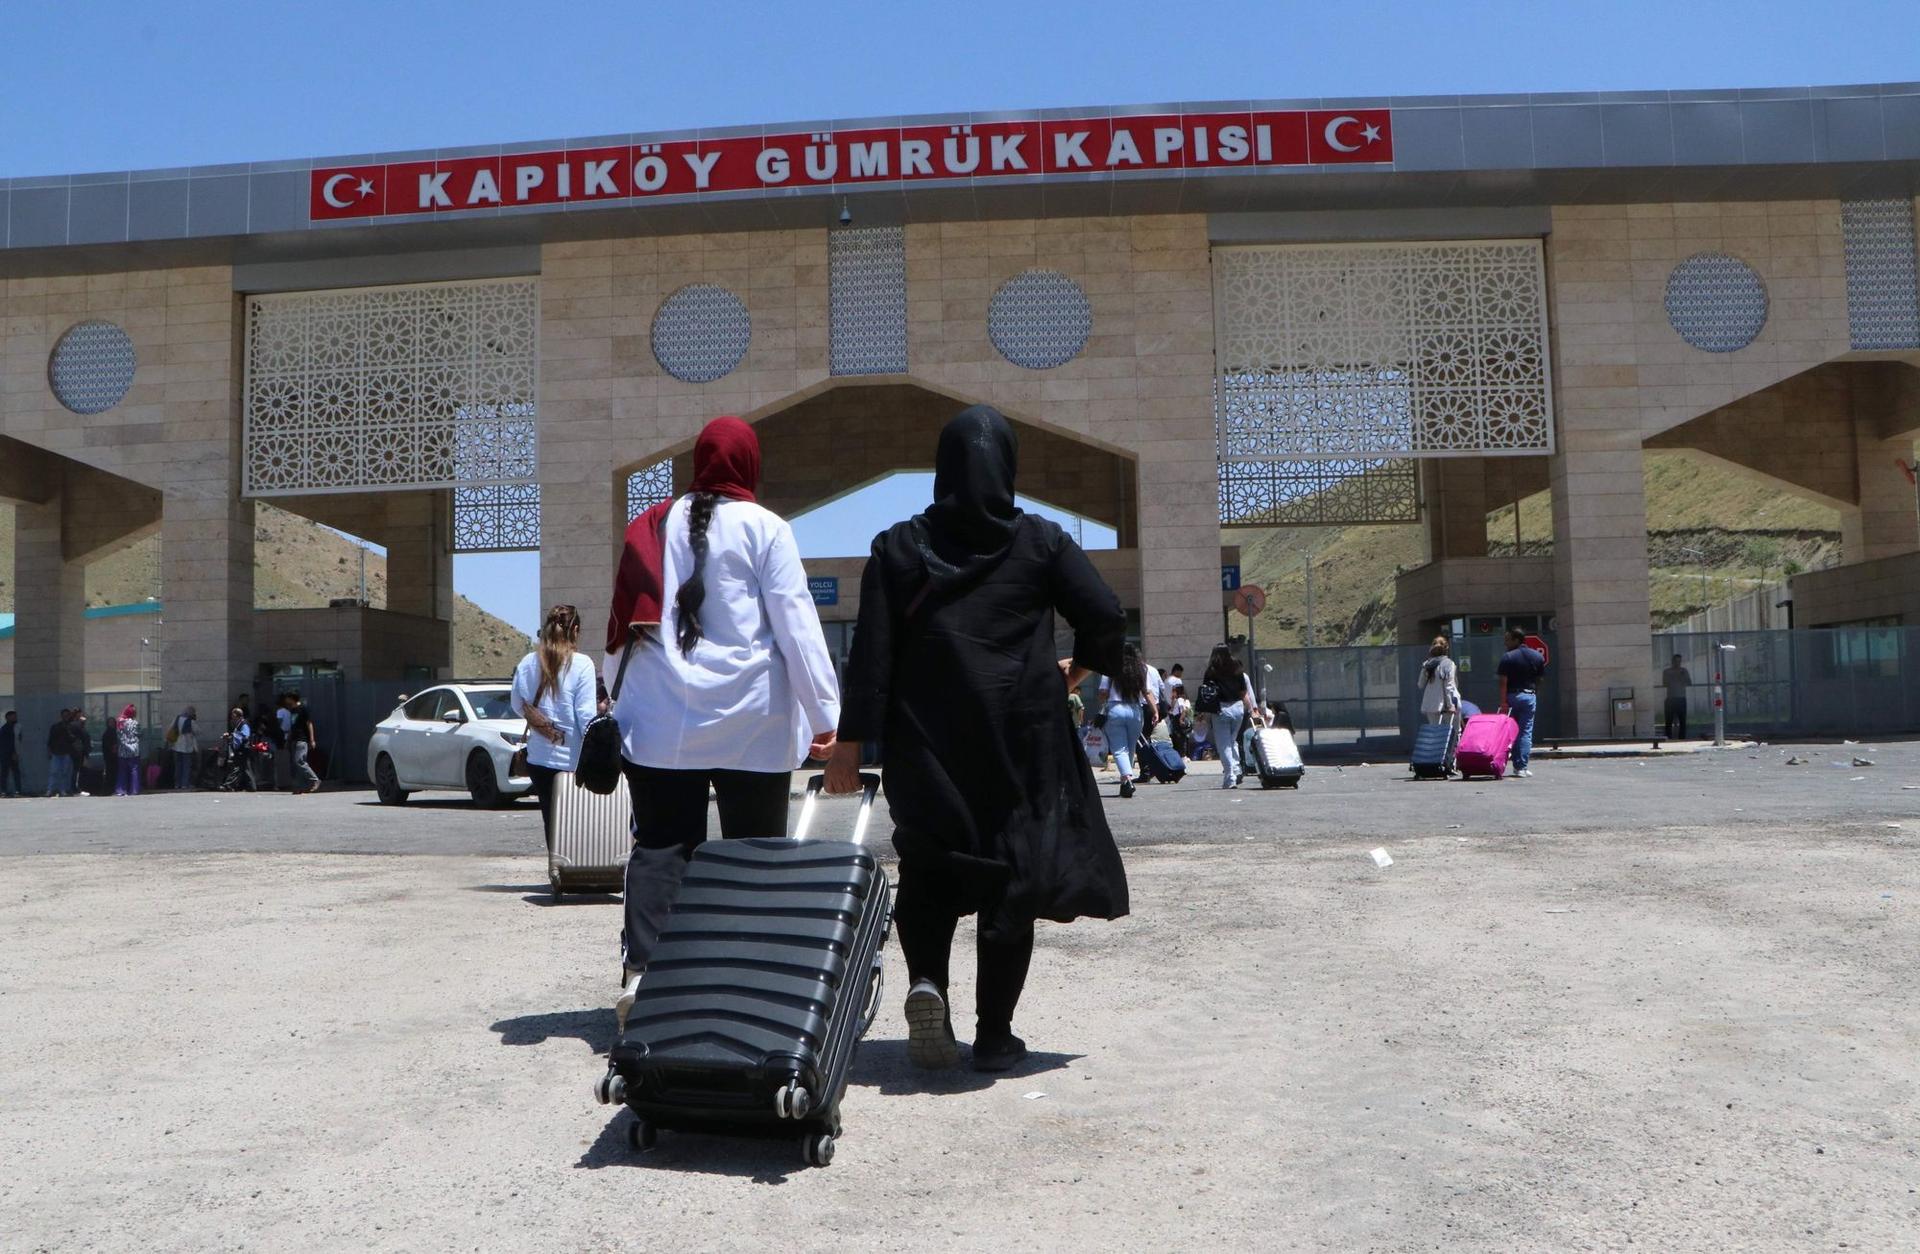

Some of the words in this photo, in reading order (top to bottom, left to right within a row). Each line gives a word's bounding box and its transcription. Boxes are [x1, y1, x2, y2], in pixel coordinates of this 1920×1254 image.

[418, 145, 722, 208] KAPIKÖY
[755, 125, 1029, 184] GÜMRÜK
[1054, 124, 1273, 168] KAPISI
